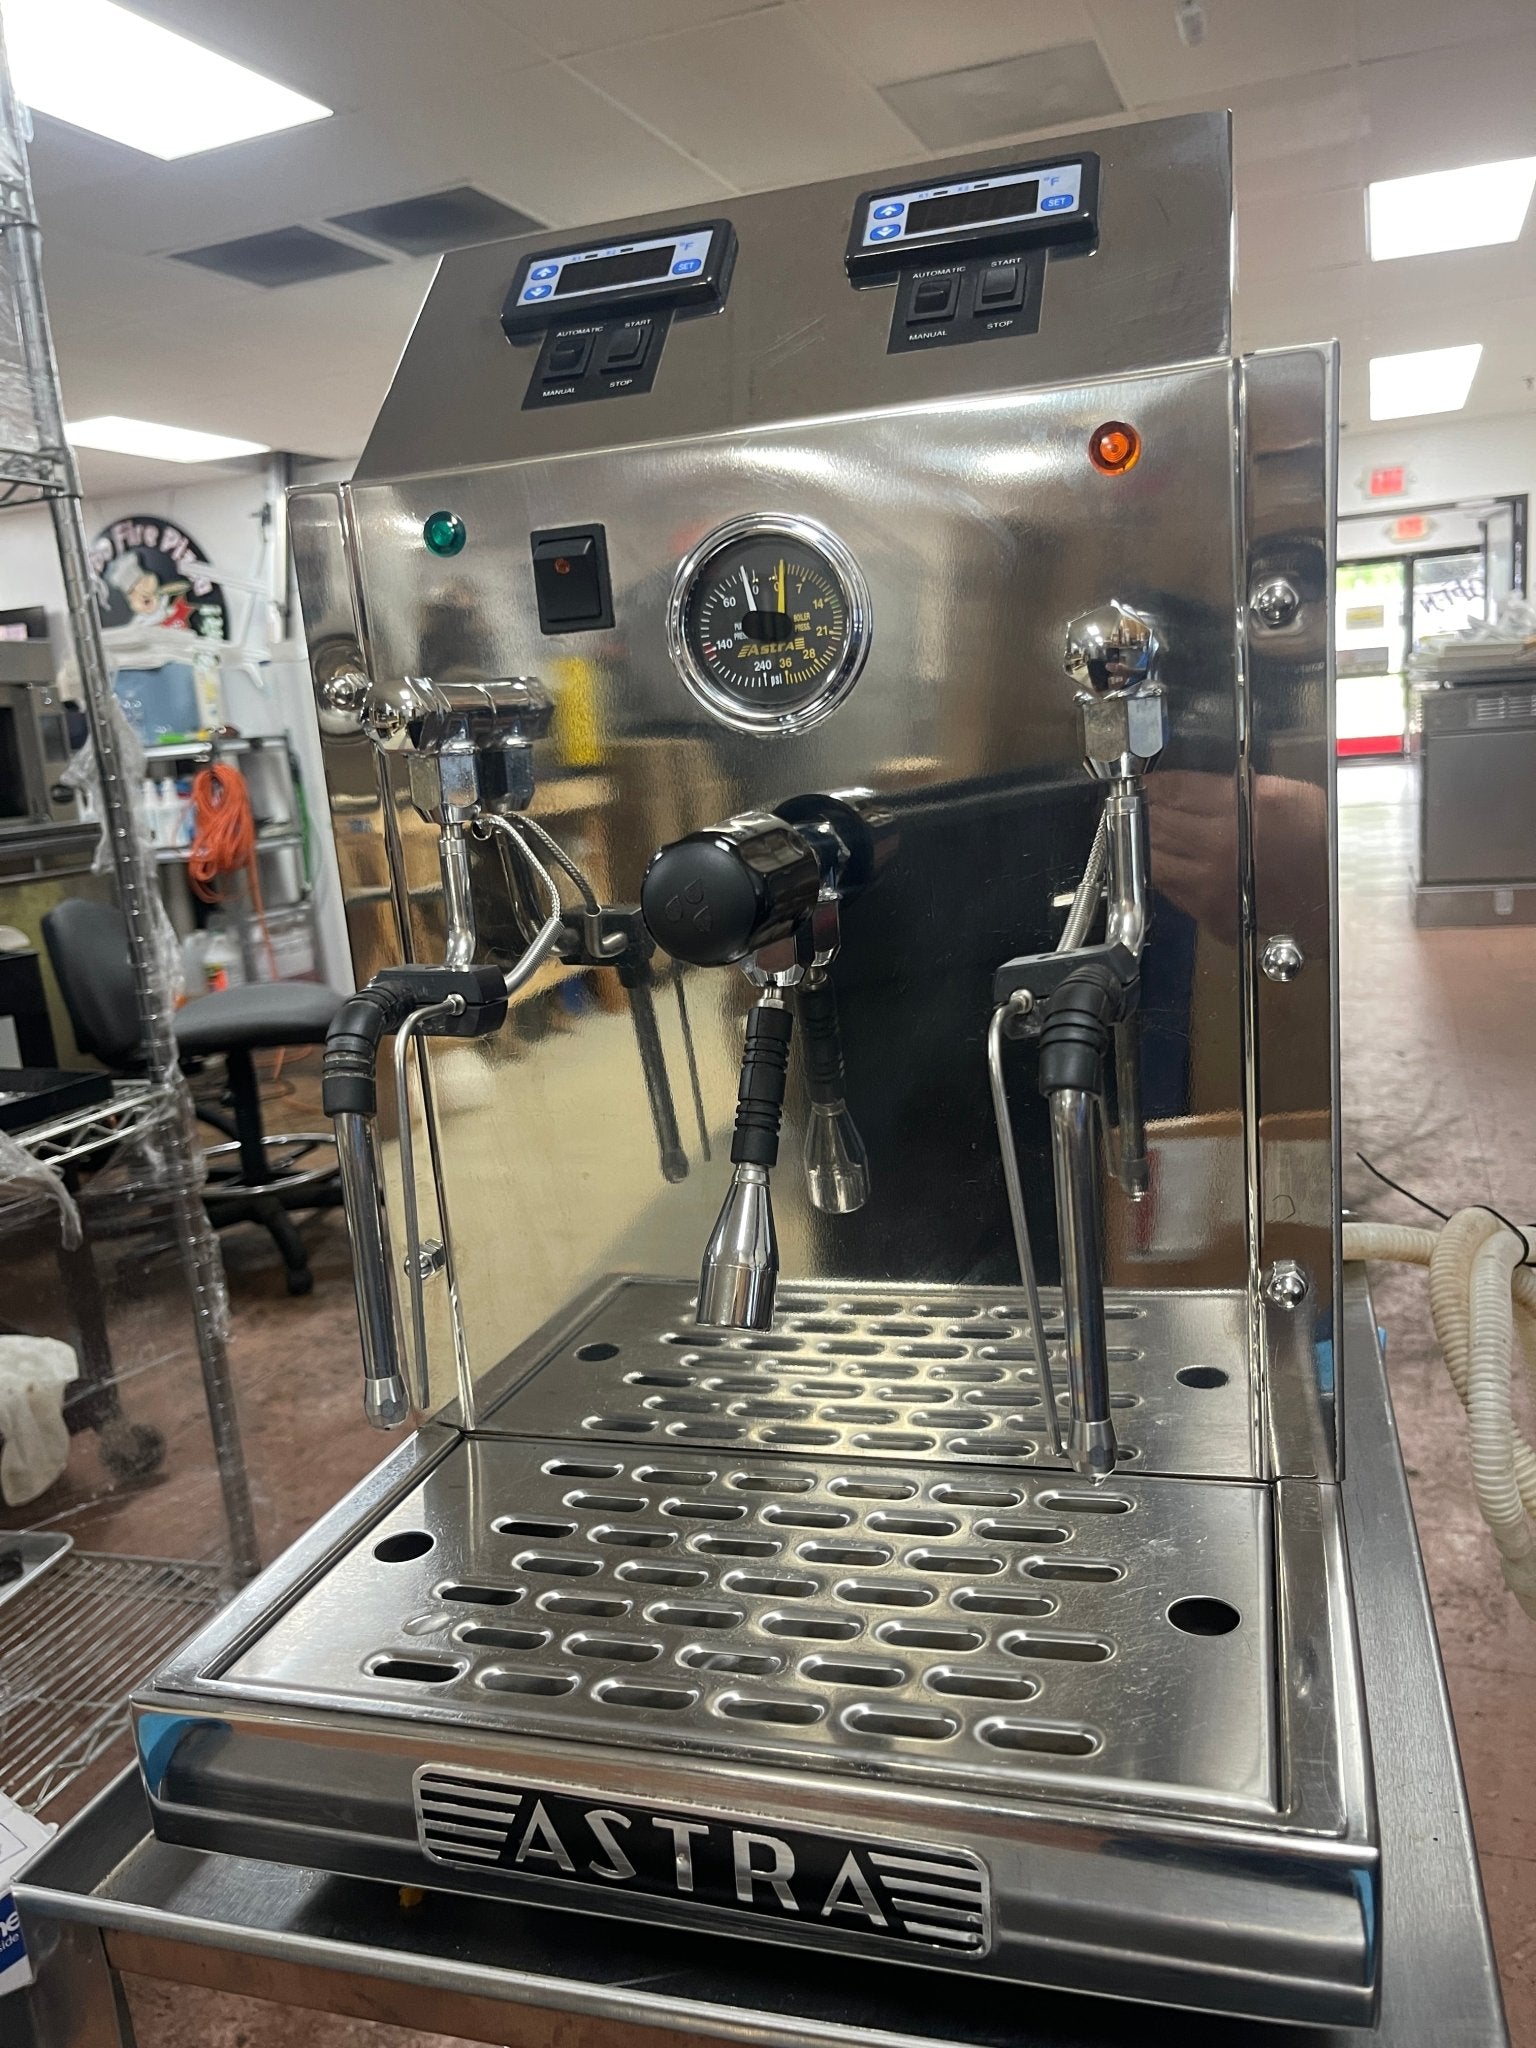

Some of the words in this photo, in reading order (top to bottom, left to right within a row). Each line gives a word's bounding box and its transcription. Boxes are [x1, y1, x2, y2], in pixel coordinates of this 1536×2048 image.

[1047, 197, 1066, 207] SET
[677, 262, 694, 271] SET
[991, 257, 1022, 268] START
[912, 265, 966, 279] AUTOMATIC
[624, 318, 652, 329] START
[986, 319, 1014, 330] STOP
[556, 325, 604, 338] AUTOMATIC
[908, 329, 948, 341] MANUAL
[609, 379, 633, 388] STOP
[542, 387, 576, 397] MANUAL
[753, 585, 759, 594] 0
[796, 584, 803, 594] 7
[723, 597, 736, 607] 60
[813, 599, 823, 609] 14
[793, 612, 811, 623] BOILER
[816, 626, 828, 636] 21
[716, 639, 732, 649] 140
[803, 649, 815, 659] 28
[753, 660, 772, 672] 240
[779, 658, 792, 668] 36
[771, 674, 782, 687] psi
[515, 1798, 889, 1927] ASTRA
